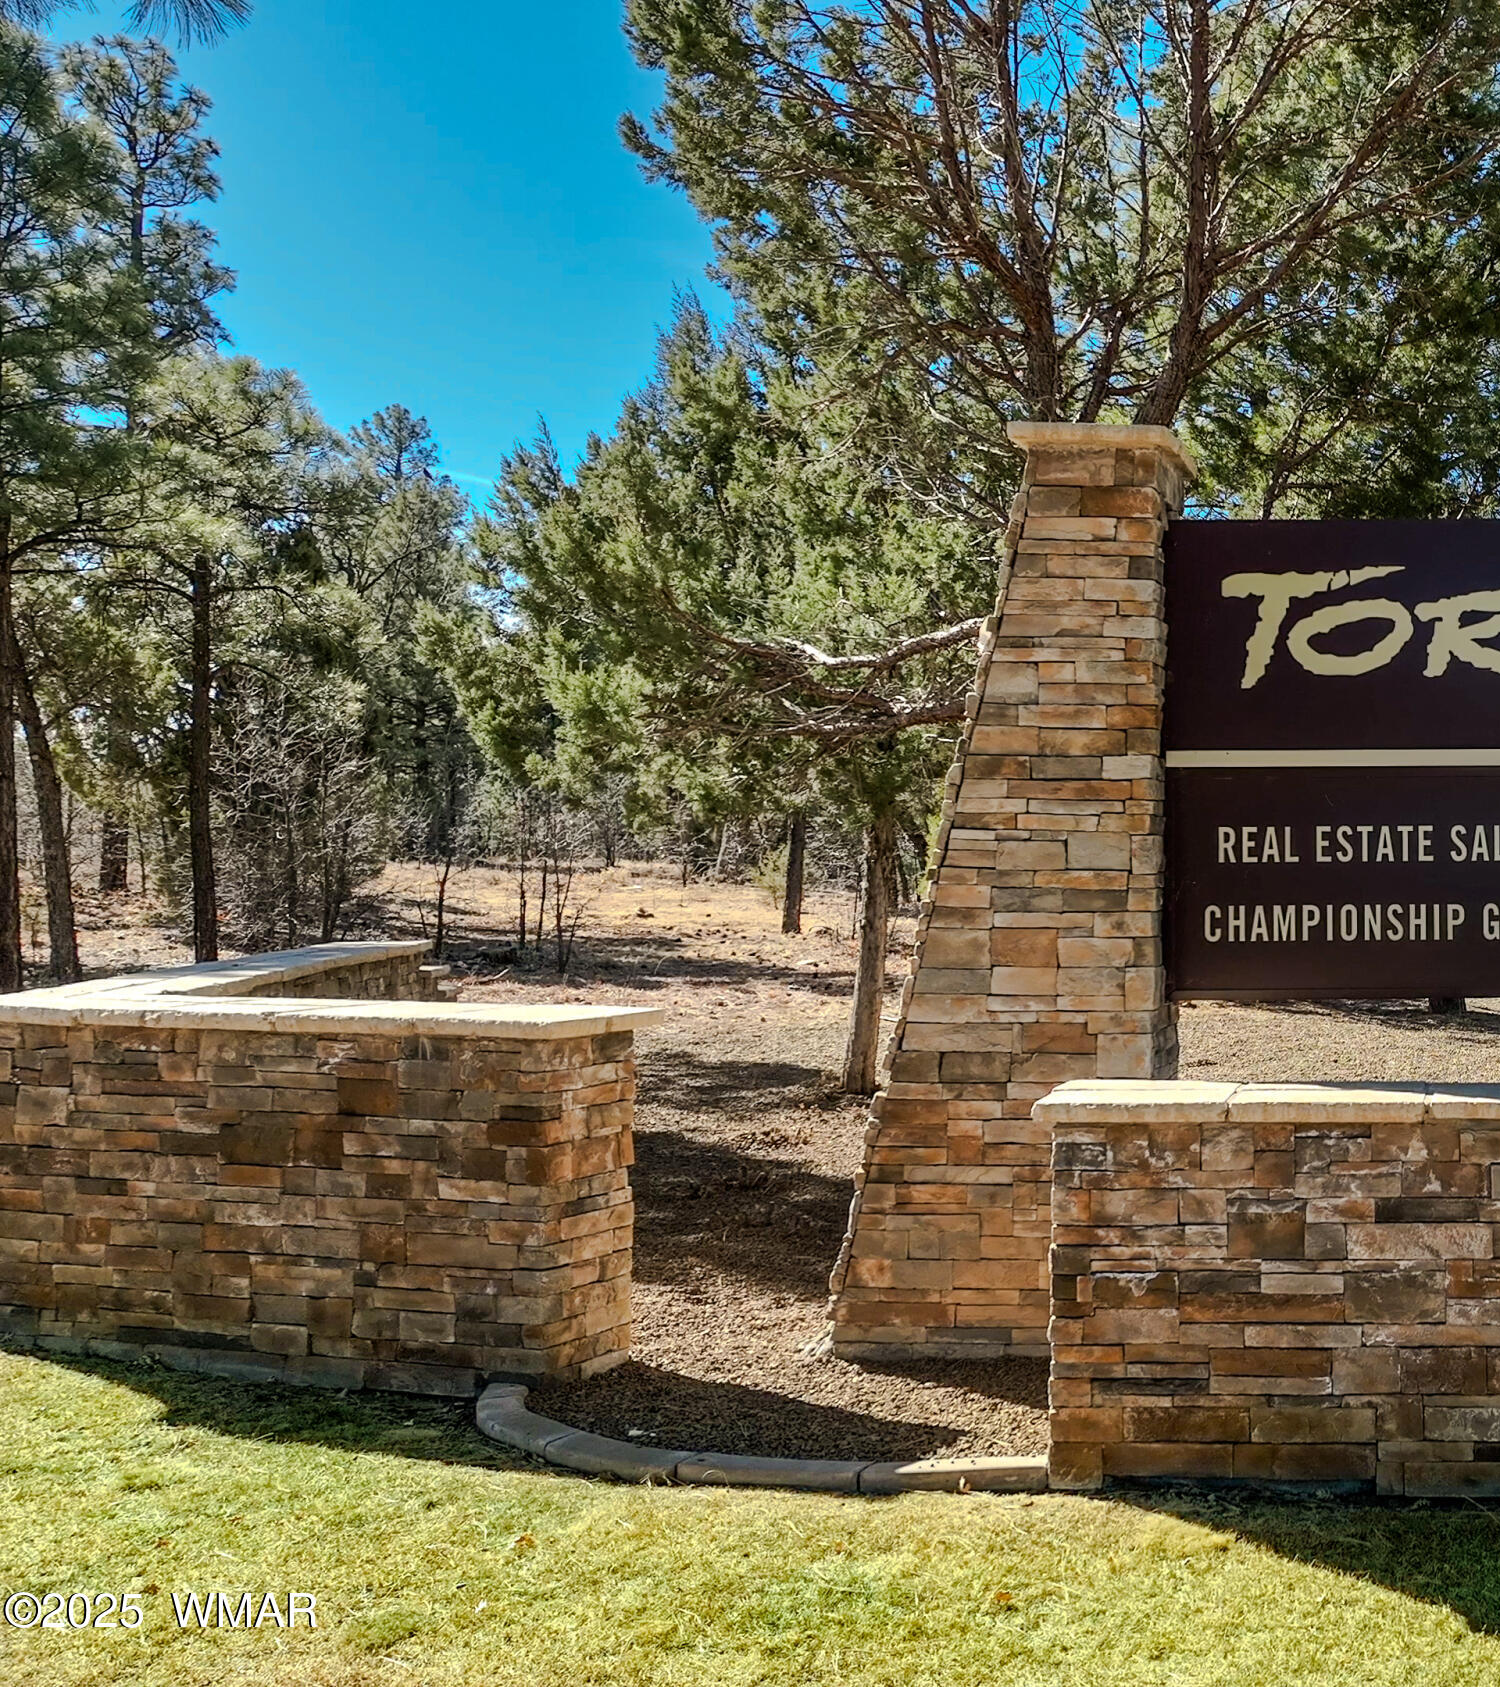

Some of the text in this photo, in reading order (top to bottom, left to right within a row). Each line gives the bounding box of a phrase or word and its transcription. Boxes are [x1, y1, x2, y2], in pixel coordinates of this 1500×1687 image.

[1217, 825, 1301, 864] REAL
[1315, 824, 1435, 864] ESTATE
[1203, 902, 1466, 943] CHAMPIONSHIP
